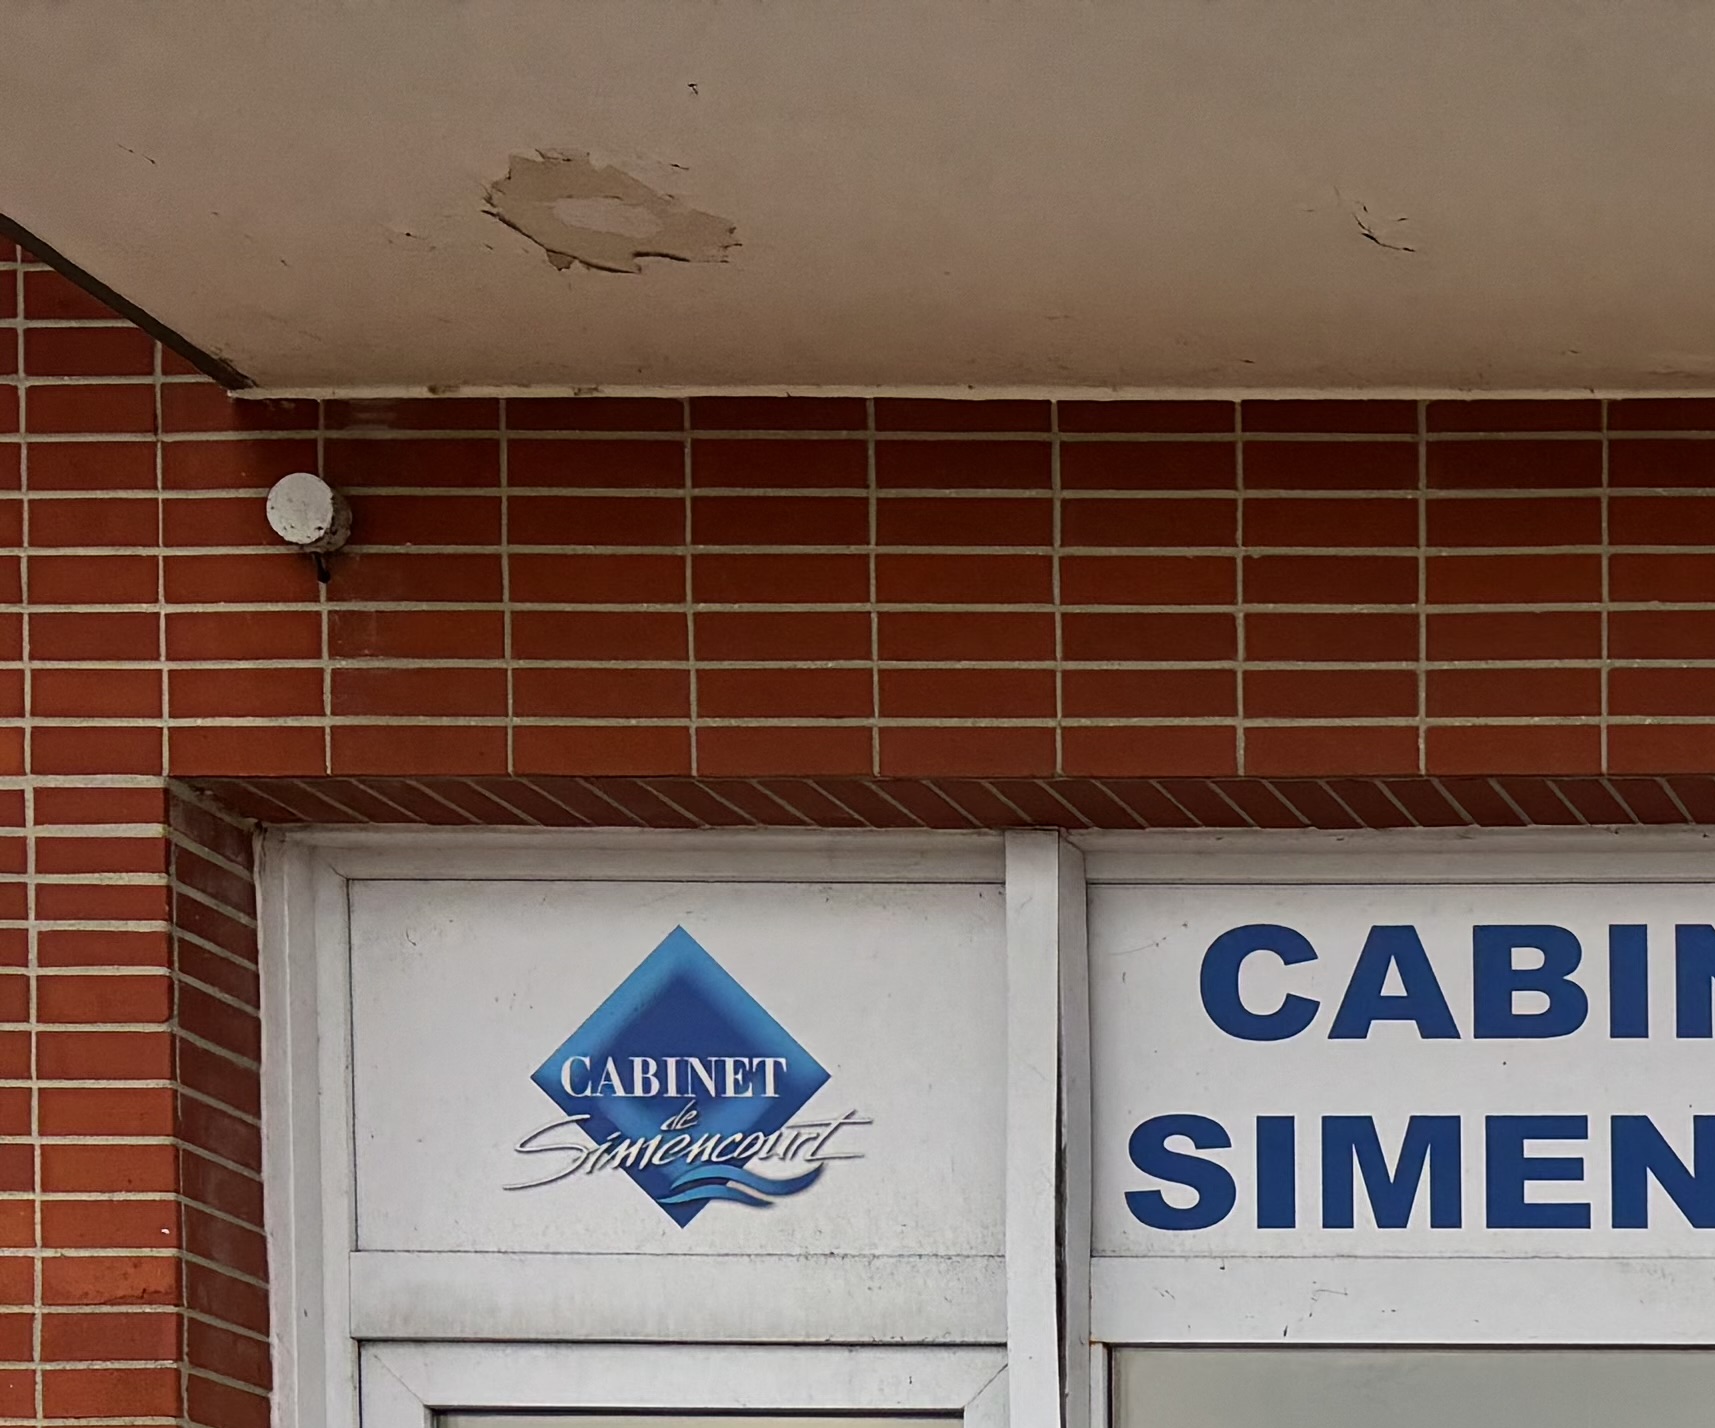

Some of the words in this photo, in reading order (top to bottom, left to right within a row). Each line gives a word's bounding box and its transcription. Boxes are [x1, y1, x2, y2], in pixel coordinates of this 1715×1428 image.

[560, 1056, 787, 1098] CABINET
[660, 1100, 698, 1131] de
[502, 1109, 874, 1191] Simencourt
